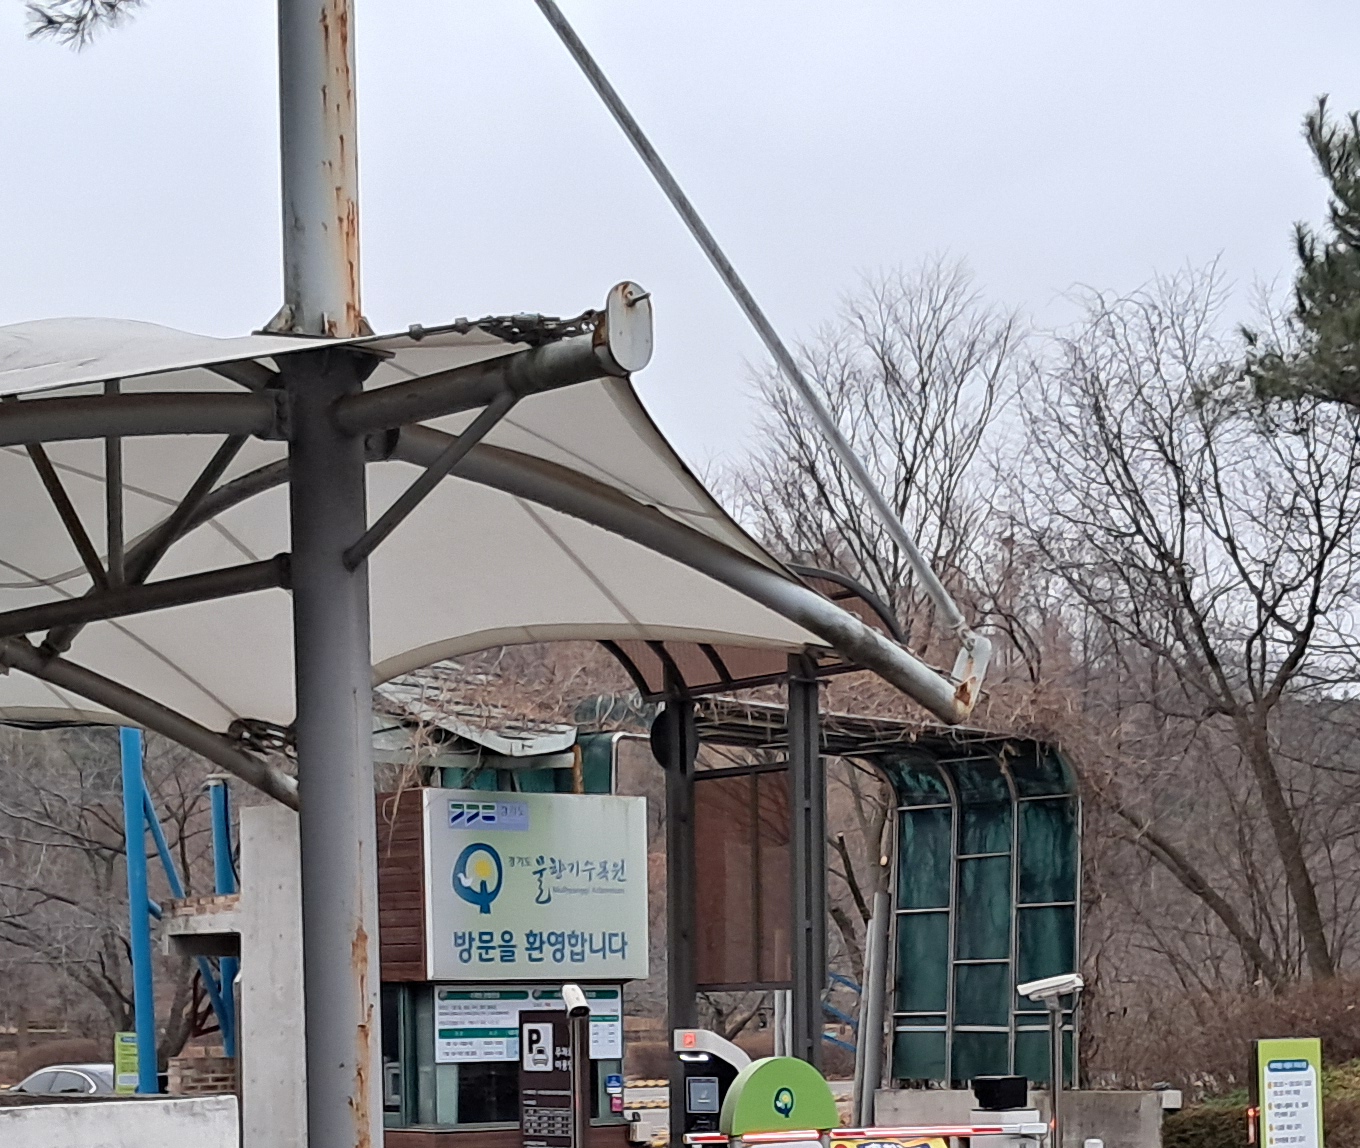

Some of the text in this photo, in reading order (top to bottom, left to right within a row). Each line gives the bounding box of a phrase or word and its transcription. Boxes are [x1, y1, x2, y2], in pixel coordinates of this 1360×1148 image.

[508, 855, 627, 904] 경기도 물향기수목원
[454, 929, 629, 964] 방문을 환영합니다
[527, 1028, 542, 1055] P
